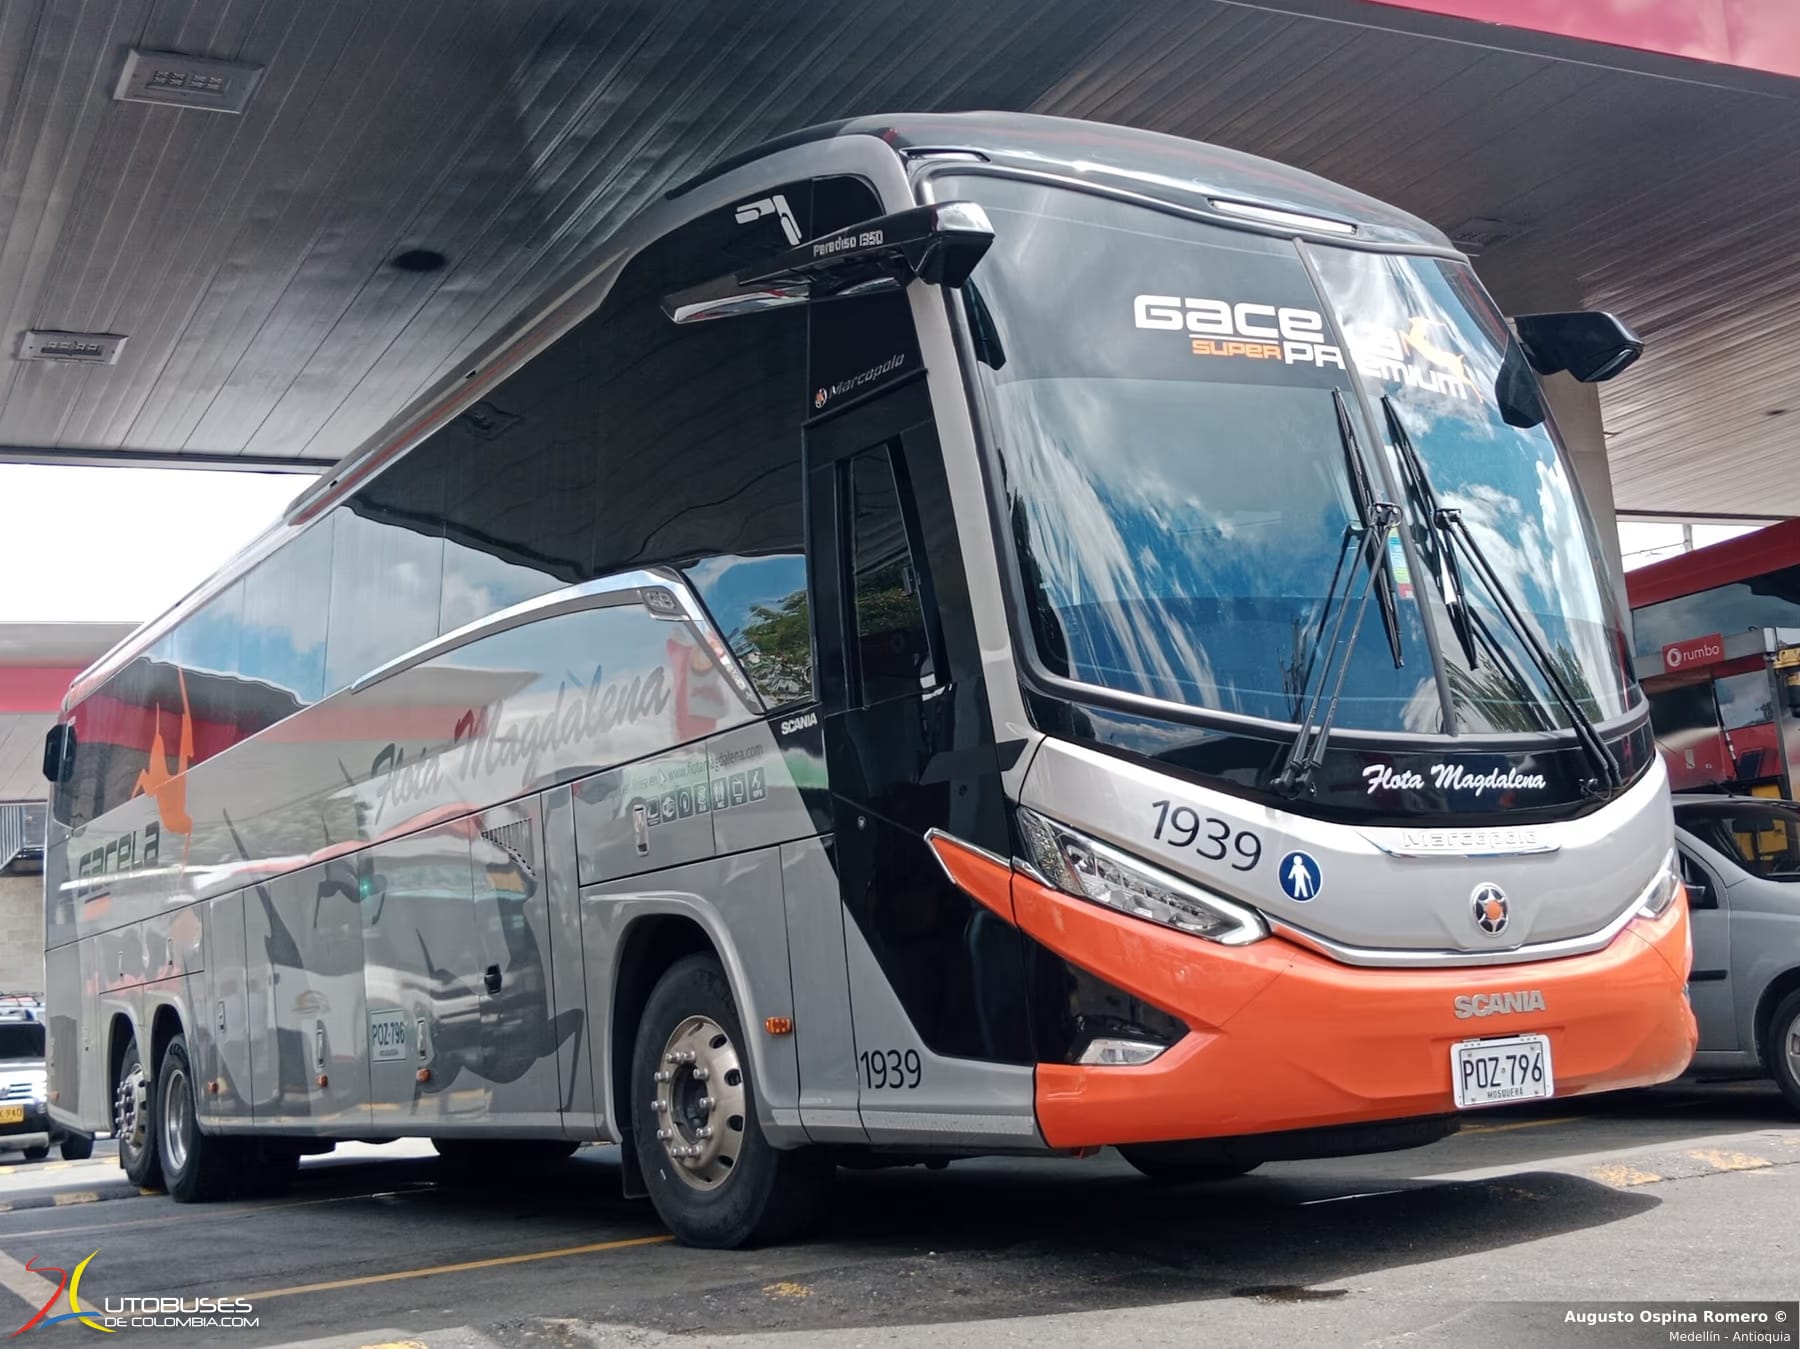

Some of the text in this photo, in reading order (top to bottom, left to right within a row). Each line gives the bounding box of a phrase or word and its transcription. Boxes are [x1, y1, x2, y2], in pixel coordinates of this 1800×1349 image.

[812, 229, 884, 258] Paradiso 1350
[1191, 339, 1282, 361] SUPER
[828, 353, 905, 400] Marcopolo
[1683, 644, 1720, 662] rumbo
[454, 663, 671, 787] Magdalena
[780, 712, 818, 735] SCANIA
[1362, 764, 1547, 797] Flota Magdalena
[1151, 800, 1262, 872] 1939
[1402, 827, 1538, 848] Marcopolo
[1454, 990, 1547, 1019] SCANIA
[860, 1048, 922, 1089] 1939
[1486, 1087, 1524, 1099] MOSQUERA
